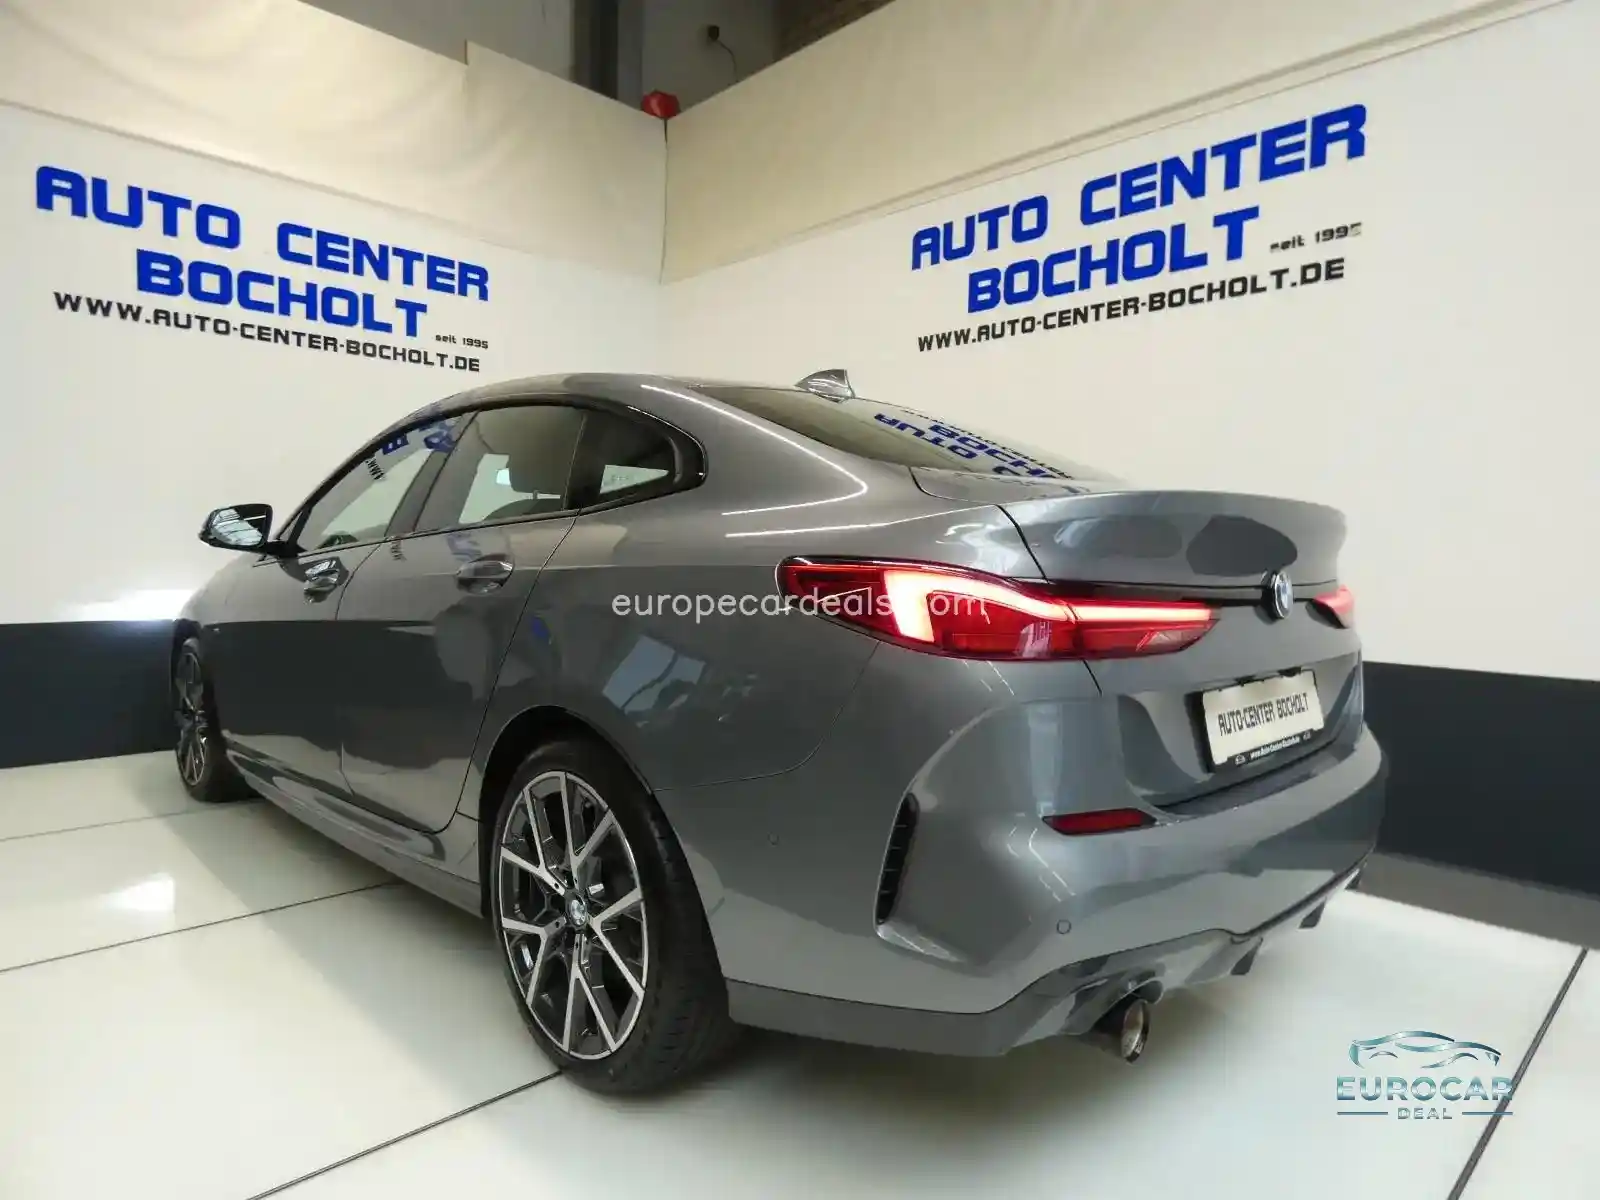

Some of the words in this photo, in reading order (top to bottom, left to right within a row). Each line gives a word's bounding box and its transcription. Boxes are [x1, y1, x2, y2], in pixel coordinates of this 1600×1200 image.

[912, 195, 1049, 270] AUTO
[1081, 103, 1367, 226] CENTER
[36, 166, 242, 250] AUTO
[276, 222, 489, 301] CENTER
[968, 206, 1260, 313] BOCHOLT
[54, 291, 480, 372] WWW.AUTO-CENTER-BOCHOLT.DE
[136, 249, 428, 337] BOCHOLT
[918, 258, 1345, 352] WWW.AUTO-CENTER-BOCHOLT.DE
[435, 334, 457, 344] seit
[462, 337, 489, 349] 1995
[1217, 701, 1275, 737] AUTO-CENTER
[1276, 692, 1310, 719] BOCHOLT
